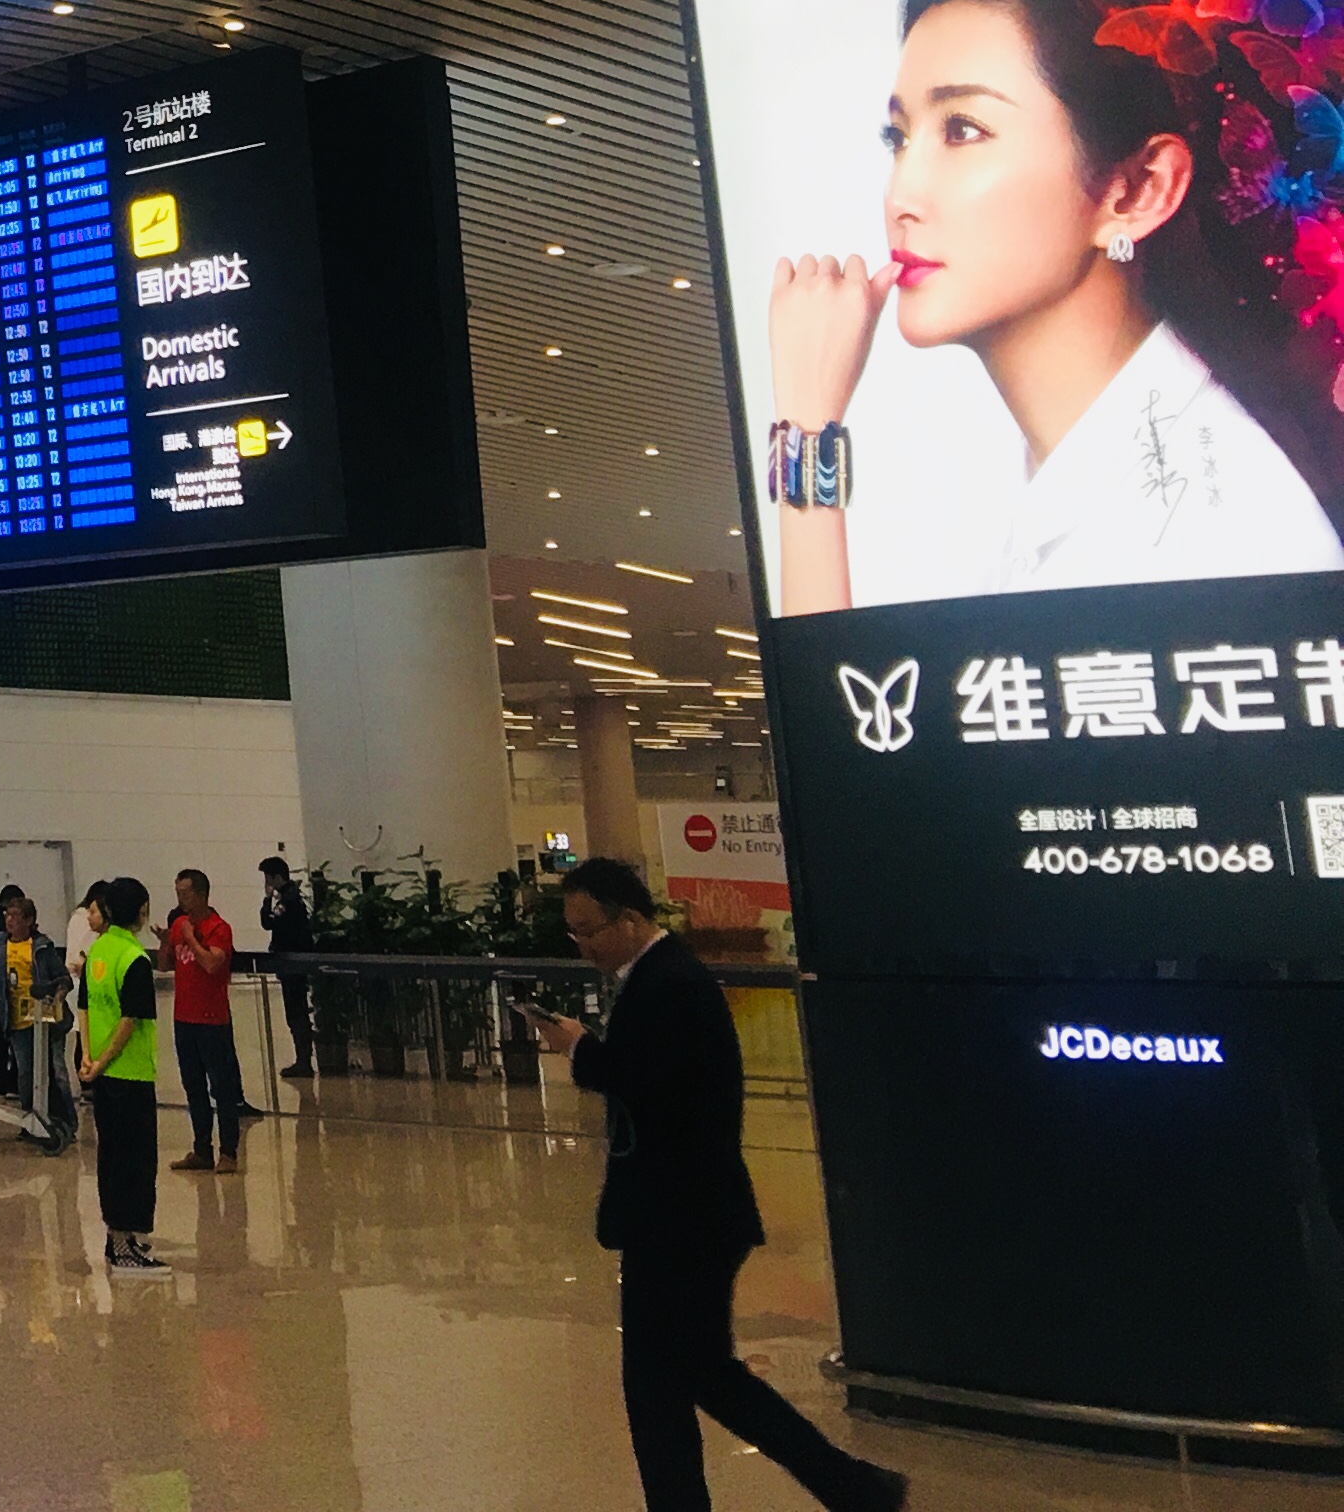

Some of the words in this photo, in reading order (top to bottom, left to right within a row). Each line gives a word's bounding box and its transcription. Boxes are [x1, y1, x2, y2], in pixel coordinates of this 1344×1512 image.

[122, 90, 212, 133] 2号航站楼
[125, 125, 186, 154] Terminal
[188, 123, 199, 140] 2
[135, 252, 251, 307] 国内到达
[140, 323, 240, 362] Domestic
[146, 355, 226, 390] Arrivals
[10, 390, 32, 405] 12:55
[13, 432, 35, 448] 13:20
[150, 488, 178, 500] Hong
[169, 500, 206, 512] Taiwan
[206, 493, 244, 509] Arrivals
[722, 813, 783, 834] 禁止通
[1018, 809, 1096, 833] 全屋设计
[1111, 807, 1198, 831] 全球招商
[722, 840, 742, 854] No
[746, 840, 782, 856] Entry
[1023, 845, 1275, 875] 400-678-1068
[1040, 1025, 1224, 1063] JCDecaux
